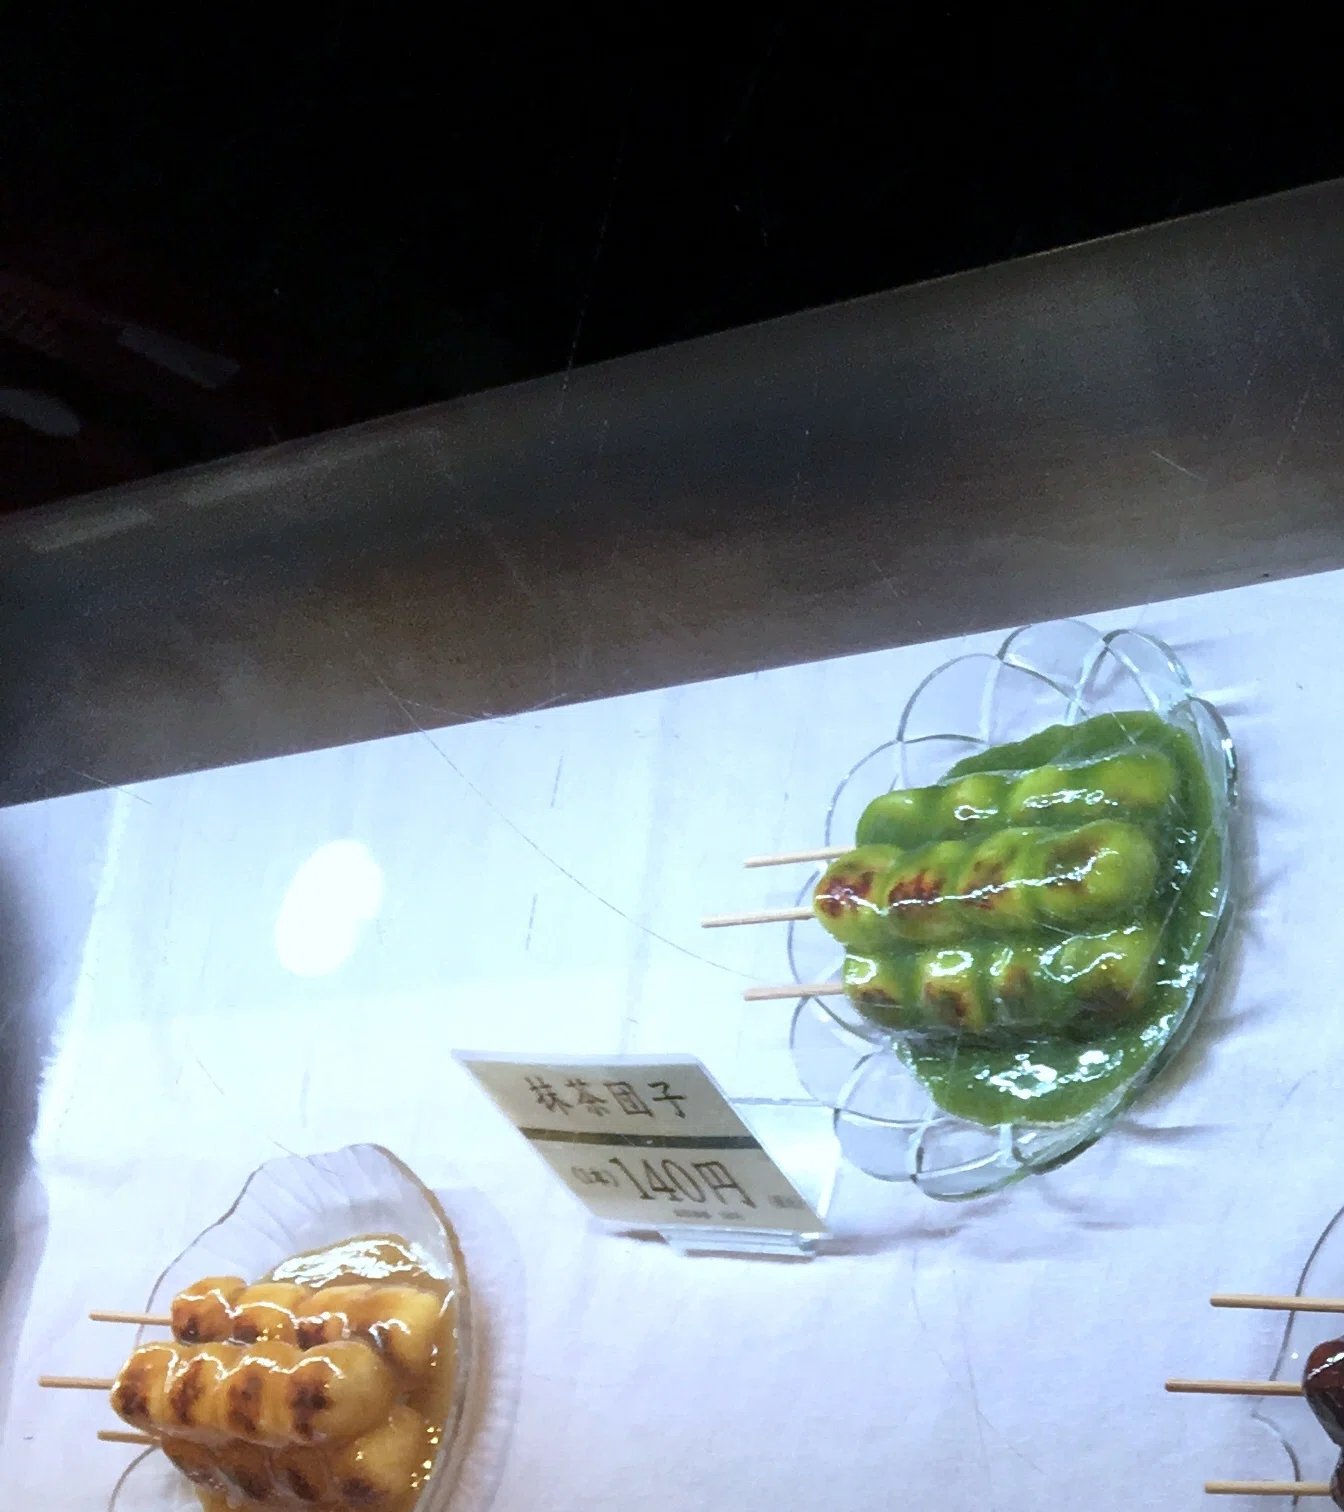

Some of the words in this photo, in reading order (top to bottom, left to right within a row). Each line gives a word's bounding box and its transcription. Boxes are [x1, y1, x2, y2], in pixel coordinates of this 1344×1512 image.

[524, 1075, 686, 1119] 抹茶団子
[609, 1156, 757, 1209] 140円
